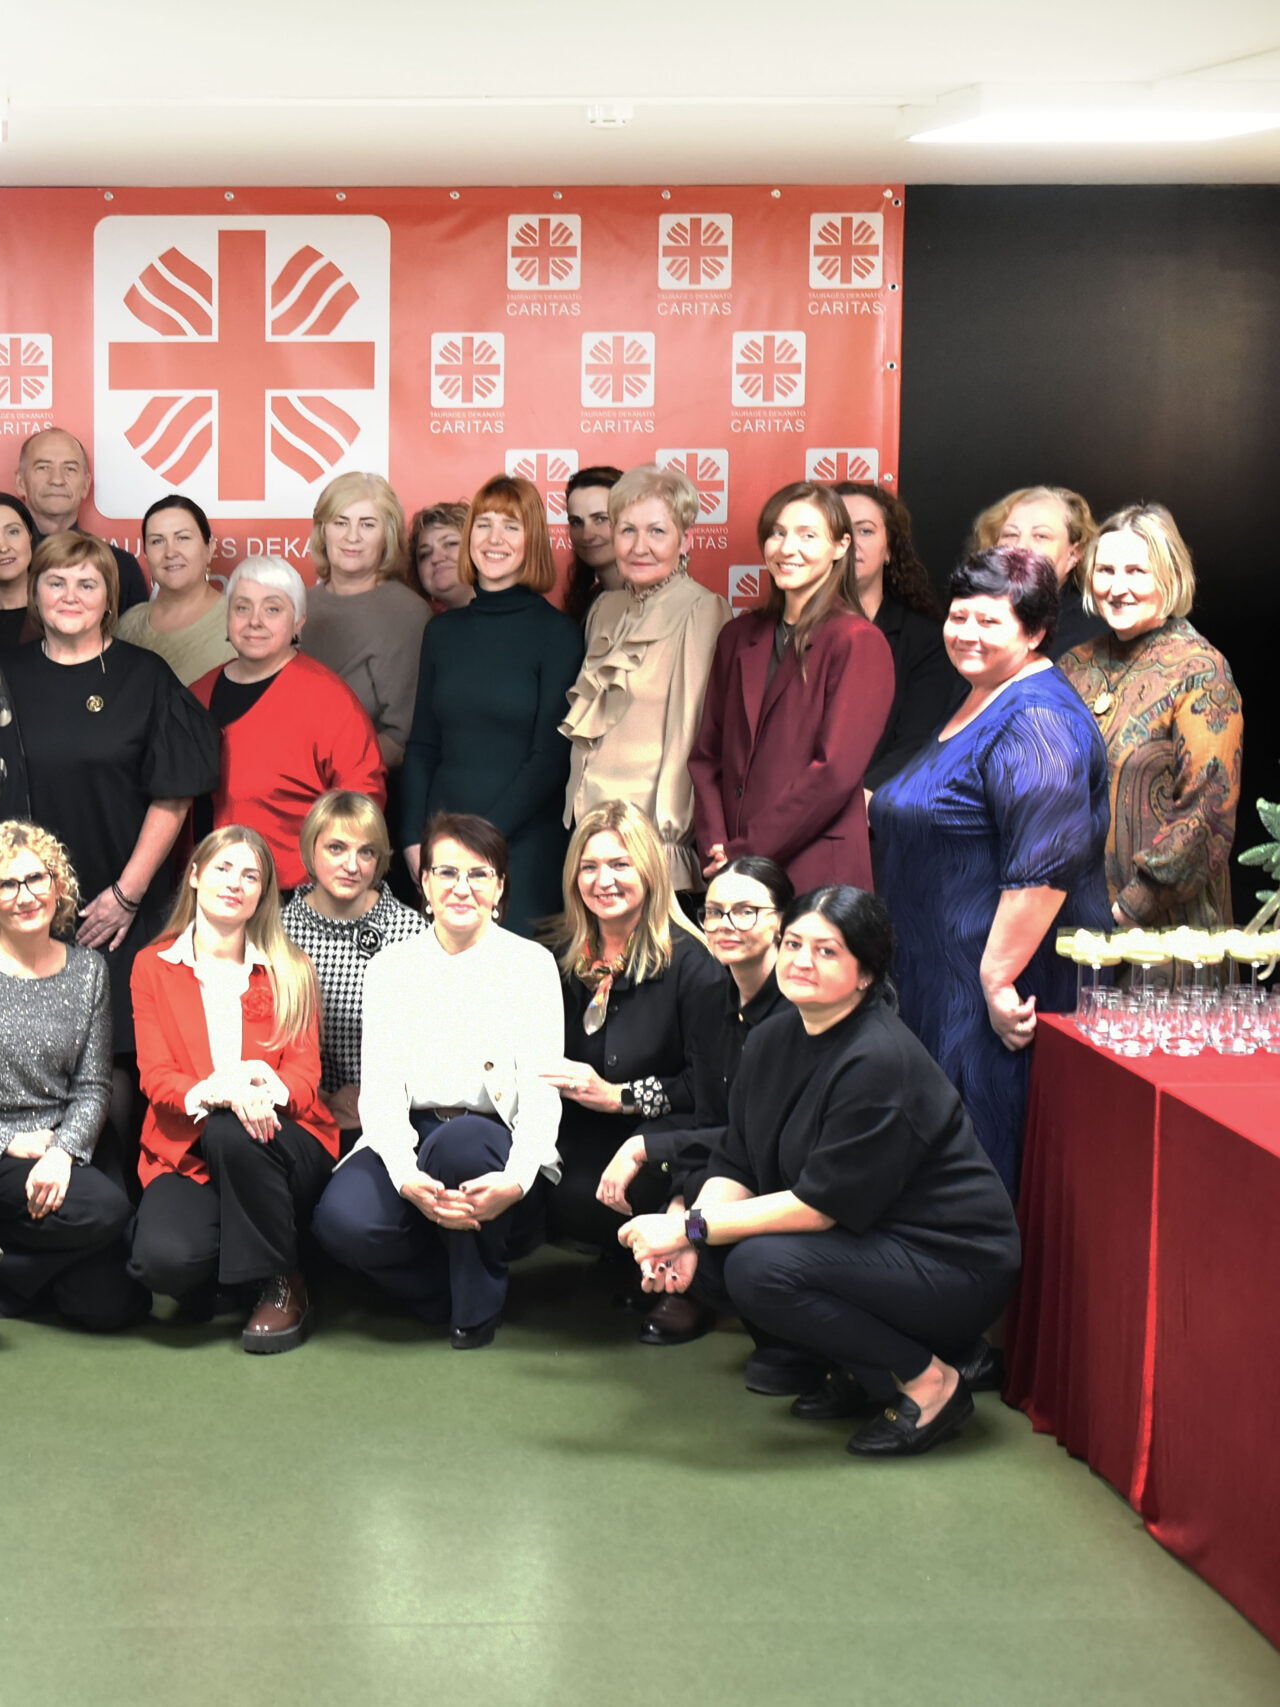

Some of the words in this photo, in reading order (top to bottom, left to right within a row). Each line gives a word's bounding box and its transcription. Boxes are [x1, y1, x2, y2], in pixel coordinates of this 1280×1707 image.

[506, 303, 581, 316] CARITAS
[657, 302, 732, 316] CARITAS
[808, 301, 882, 315] CARITAS
[430, 420, 504, 434] CARITAS
[580, 419, 655, 433] CARITAS
[731, 419, 805, 432] CARITAS
